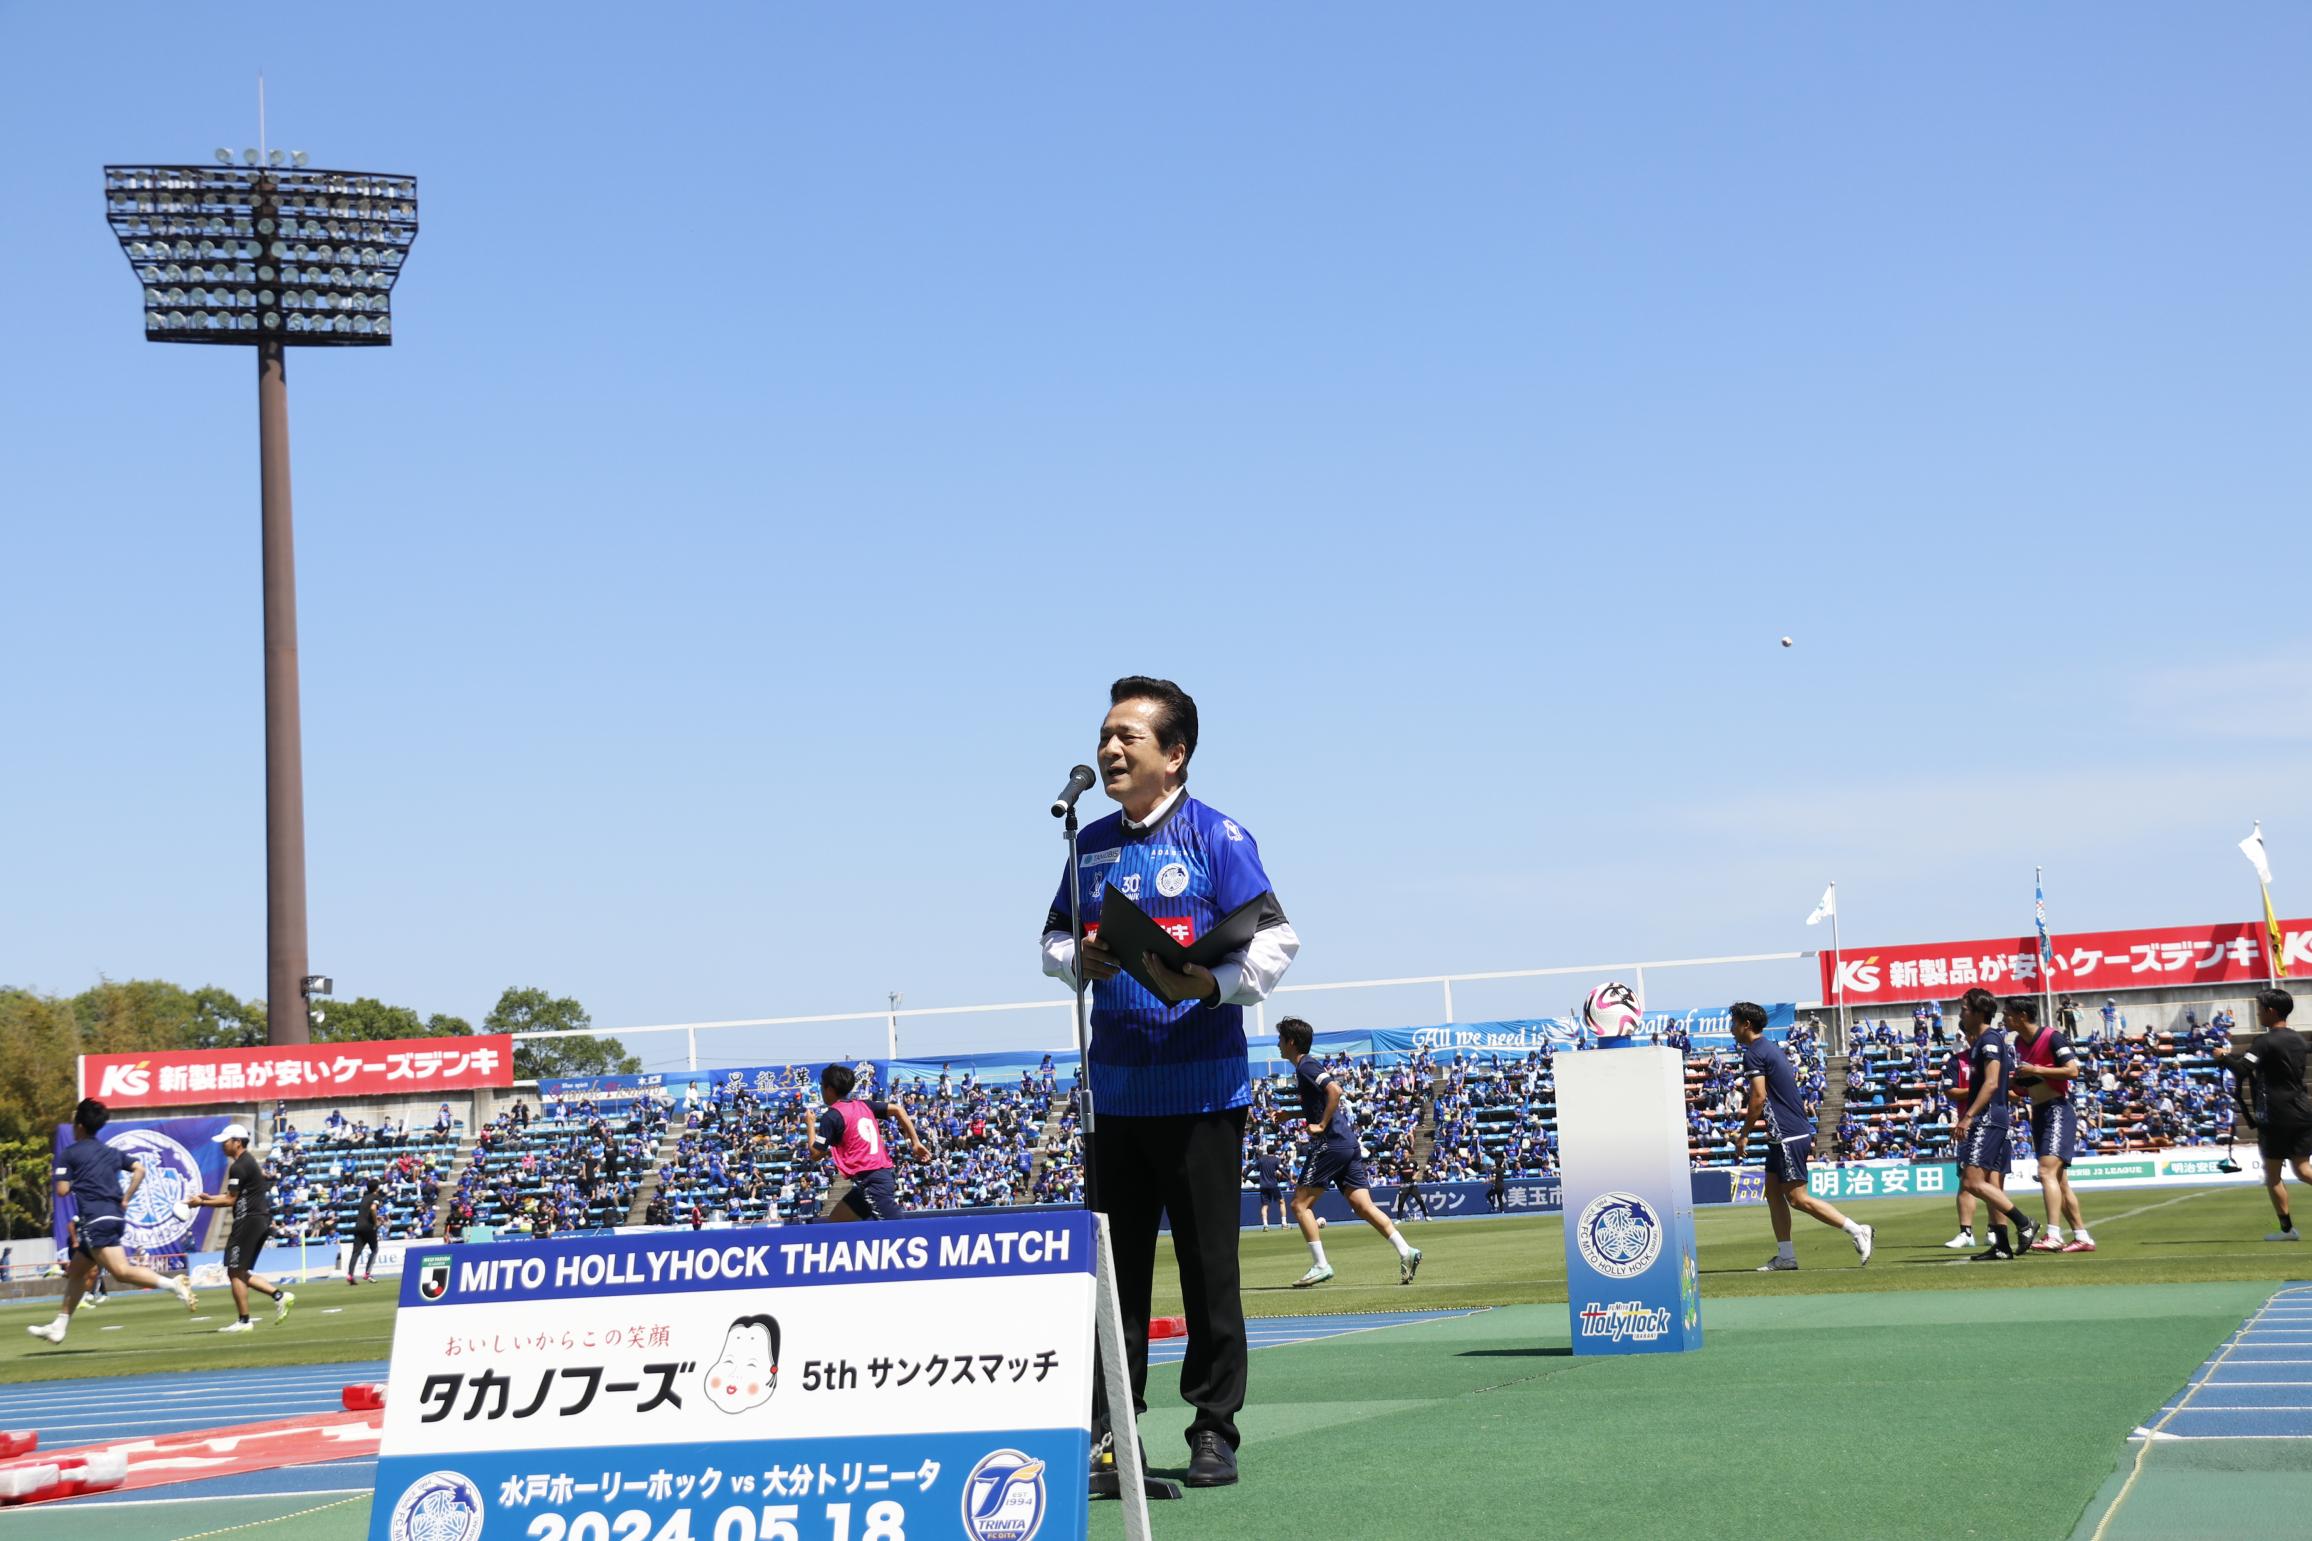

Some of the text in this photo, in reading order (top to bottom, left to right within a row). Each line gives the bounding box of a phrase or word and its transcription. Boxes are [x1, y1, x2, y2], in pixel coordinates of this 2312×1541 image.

[1889, 936, 2258, 988] 新製品が安いケーズデンキ
[1455, 1030, 1481, 1045] we
[1487, 1026, 1526, 1047] need
[1700, 1009, 1733, 1033] mit
[158, 1047, 499, 1093] 新製品が安いケーズデンキ
[857, 1117, 880, 1155] 9
[1811, 1167, 1944, 1196] 明治安田
[1580, 1226, 1589, 1239] FC
[458, 1228, 1071, 1293] MITO HOLLYHOCK THANKS MATCH
[1581, 1240, 1599, 1263] MITO
[1598, 1261, 1627, 1275] HOLLY
[1628, 1252, 1652, 1273] HOCK
[444, 1323, 671, 1357] おいしいからこの笑顔
[802, 1348, 1060, 1392] 5th サンクスマッチ
[419, 1360, 697, 1424] タカノフーズ
[498, 1466, 723, 1507] 水戸ホーリーホック
[762, 1458, 942, 1499] 大分トリニータ
[1006, 1498, 1033, 1506] 1994
[978, 1519, 1026, 1531] TRINITA
